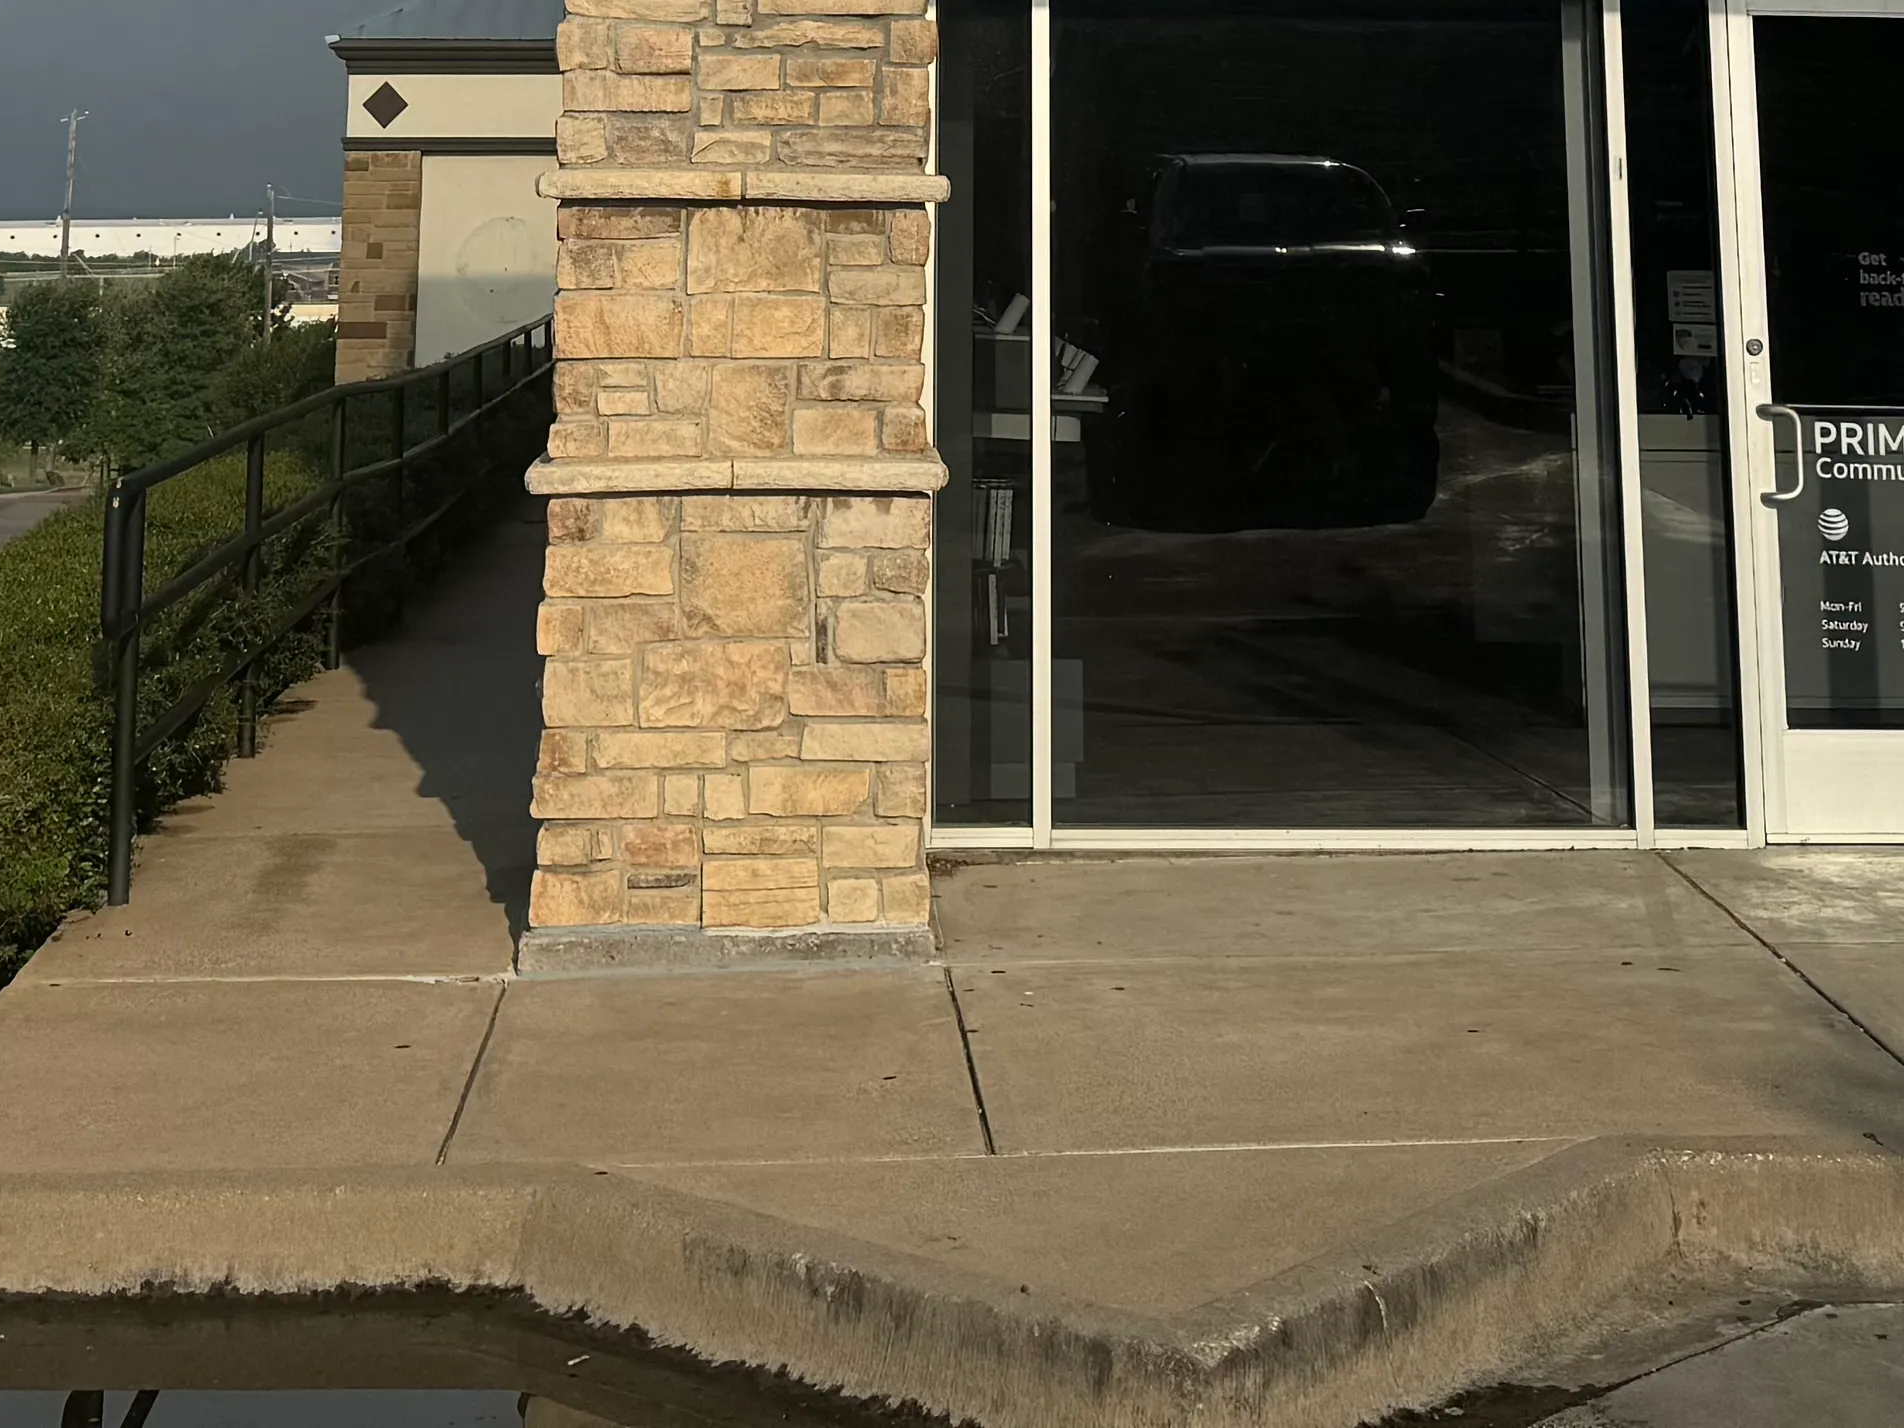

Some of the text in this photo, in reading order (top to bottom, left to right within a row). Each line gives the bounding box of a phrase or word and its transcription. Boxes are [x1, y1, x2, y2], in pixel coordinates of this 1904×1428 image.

[1858, 252, 1888, 266] Get
[1819, 550, 1859, 565] AT&T
[1820, 601, 1862, 612] Mon-Fri
[1821, 619, 1868, 634] Saturday
[1822, 637, 1861, 651] Sunday
